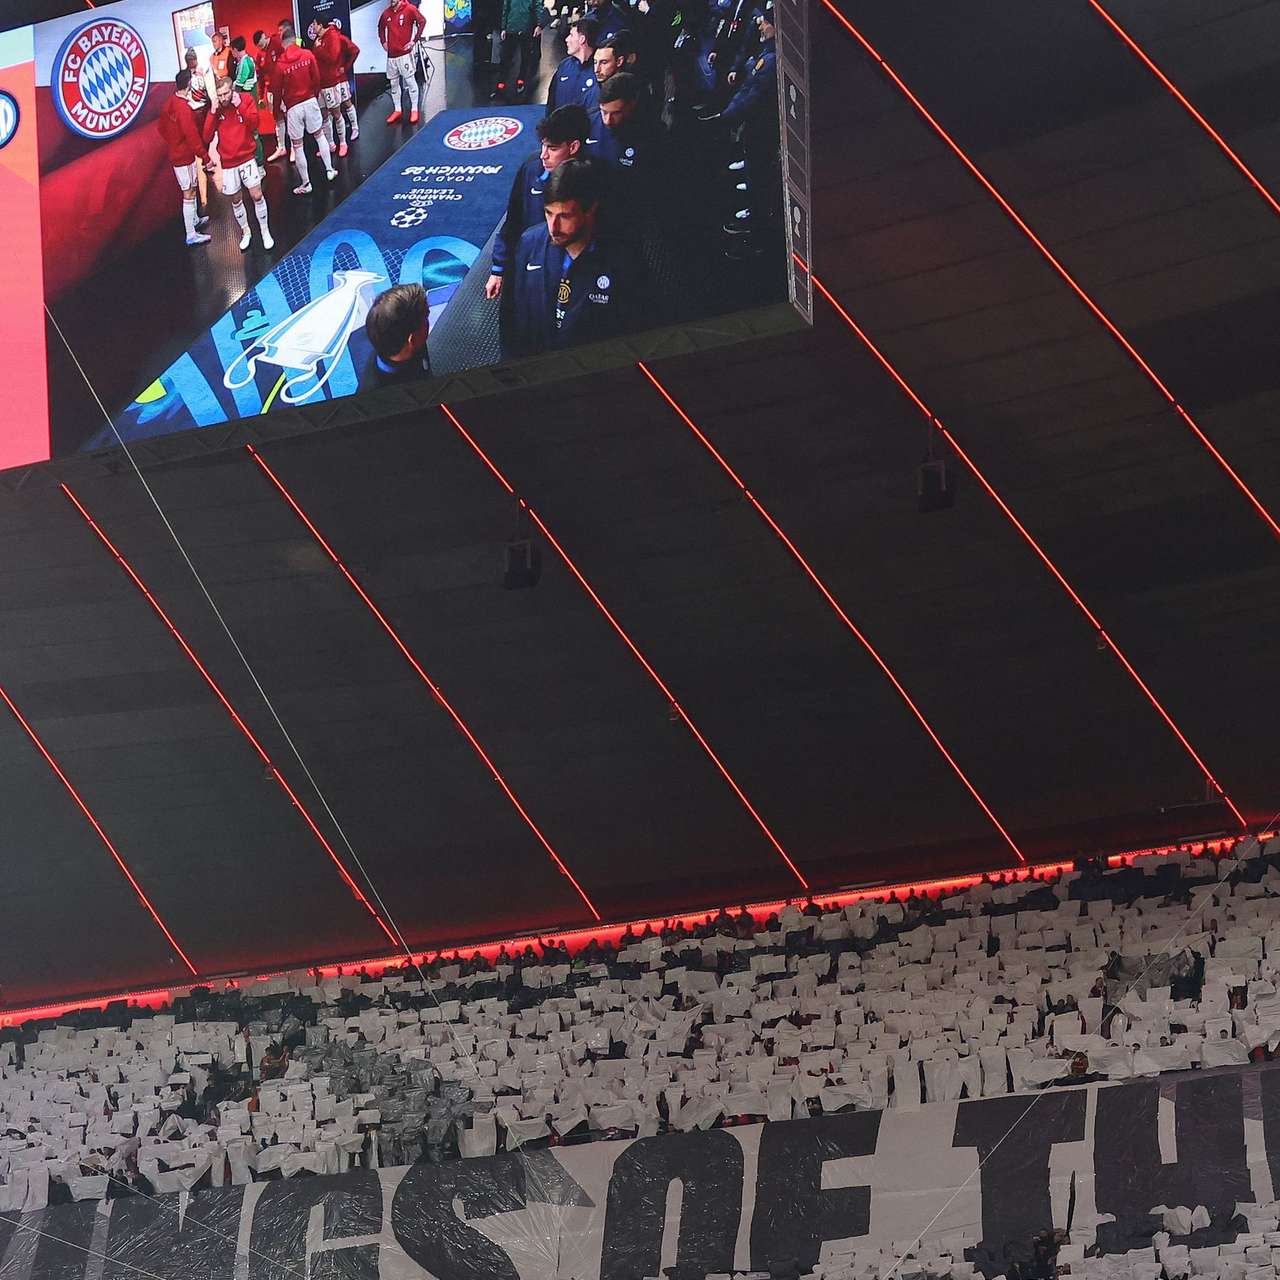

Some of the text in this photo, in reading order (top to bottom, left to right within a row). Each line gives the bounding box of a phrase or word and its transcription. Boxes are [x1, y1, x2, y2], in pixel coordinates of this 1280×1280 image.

[63, 24, 142, 83] FC BAYERN
[71, 76, 146, 132] MÜNCHEN
